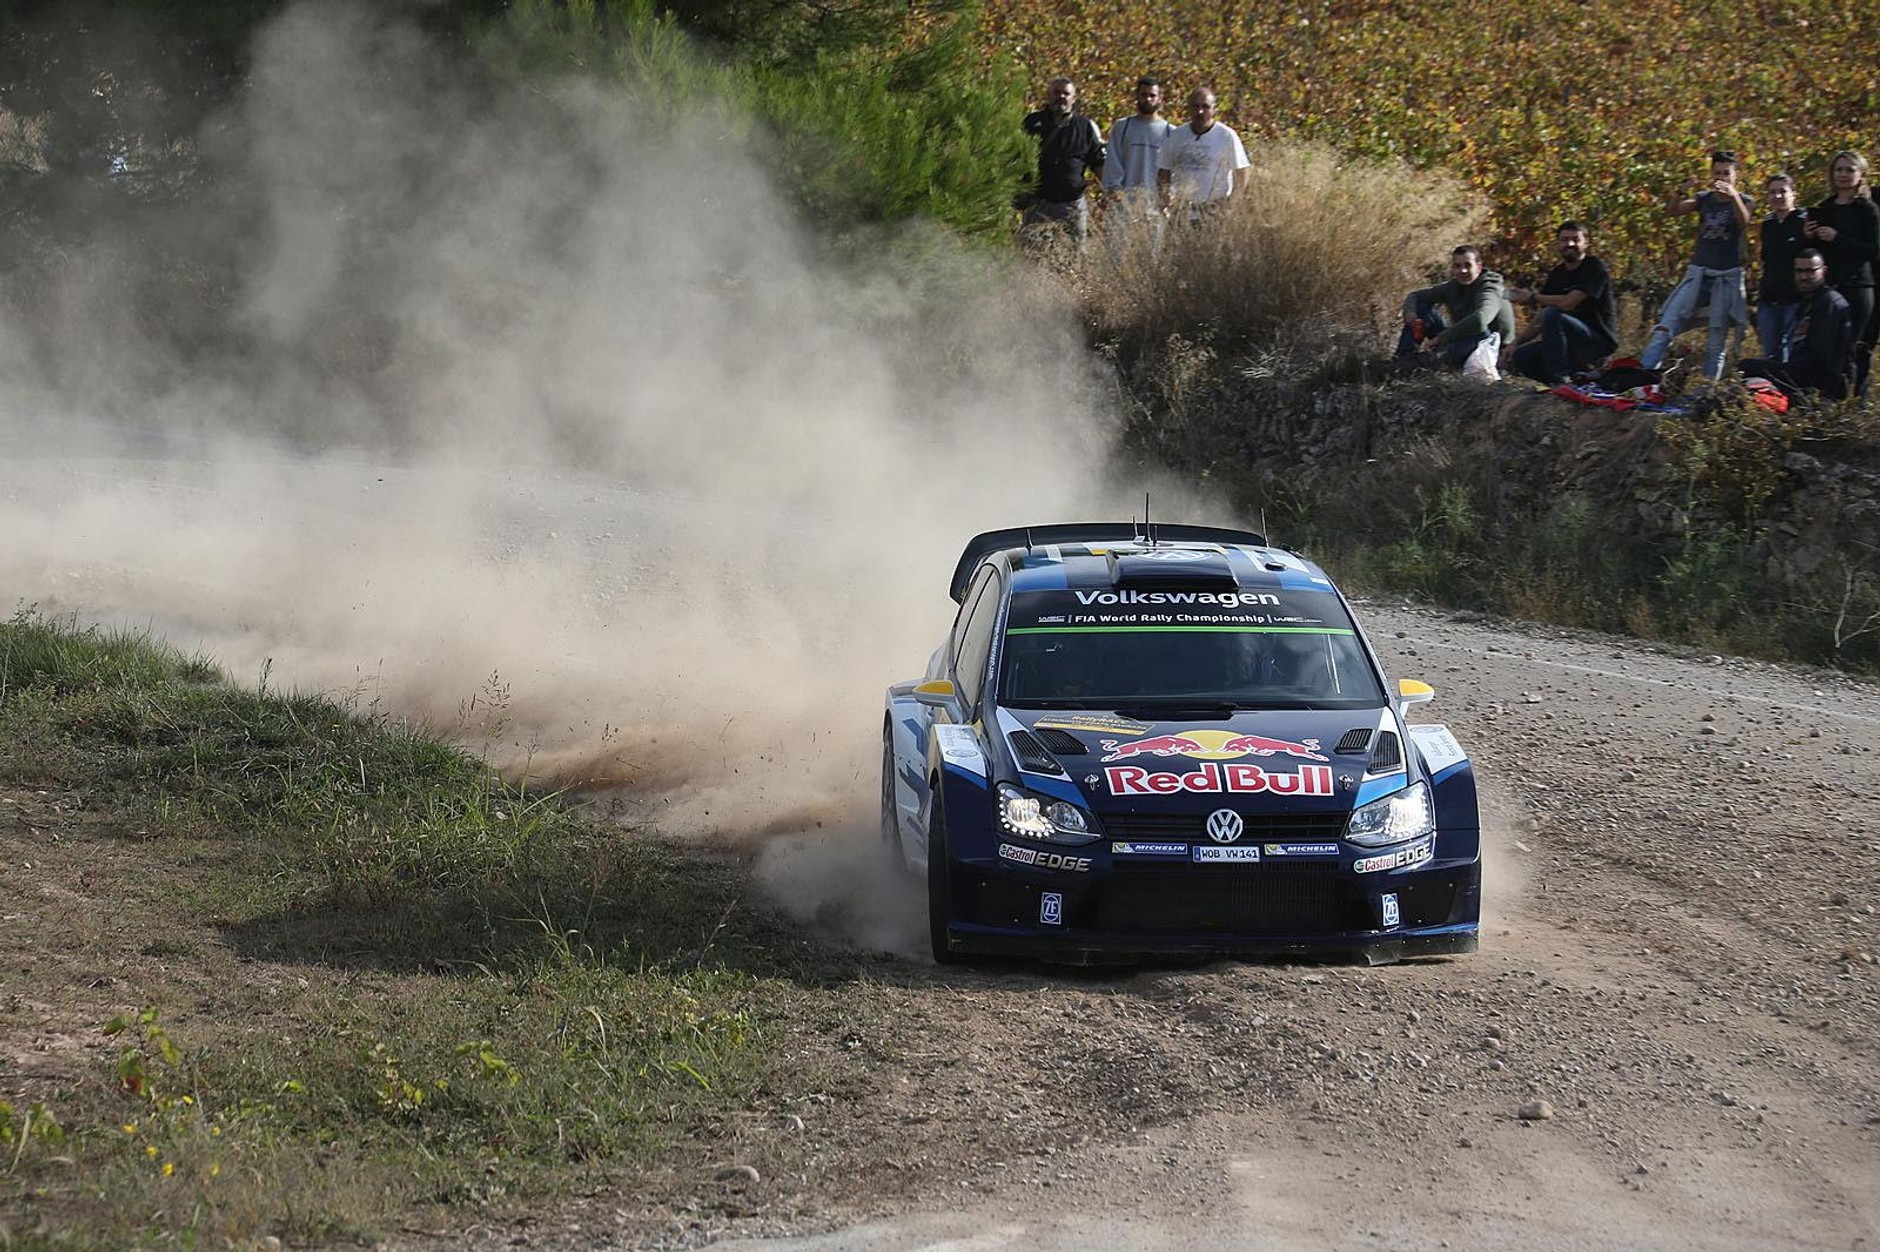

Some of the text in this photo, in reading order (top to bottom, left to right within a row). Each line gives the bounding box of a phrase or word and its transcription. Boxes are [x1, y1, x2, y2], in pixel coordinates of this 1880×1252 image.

[1075, 589, 1280, 609] Volkswagen
[1075, 615, 1096, 623] FIA
[1100, 614, 1136, 623] World
[1141, 614, 1173, 623] Rally
[1176, 614, 1265, 624] Championship
[1105, 764, 1333, 796] Red Bull
[1207, 810, 1242, 842] VW
[1005, 846, 1093, 872] Castrol EDGE
[1201, 849, 1259, 859] WOB VW 141
[1365, 842, 1431, 872] Castrol EDGE
[1044, 899, 1059, 917] ZF
